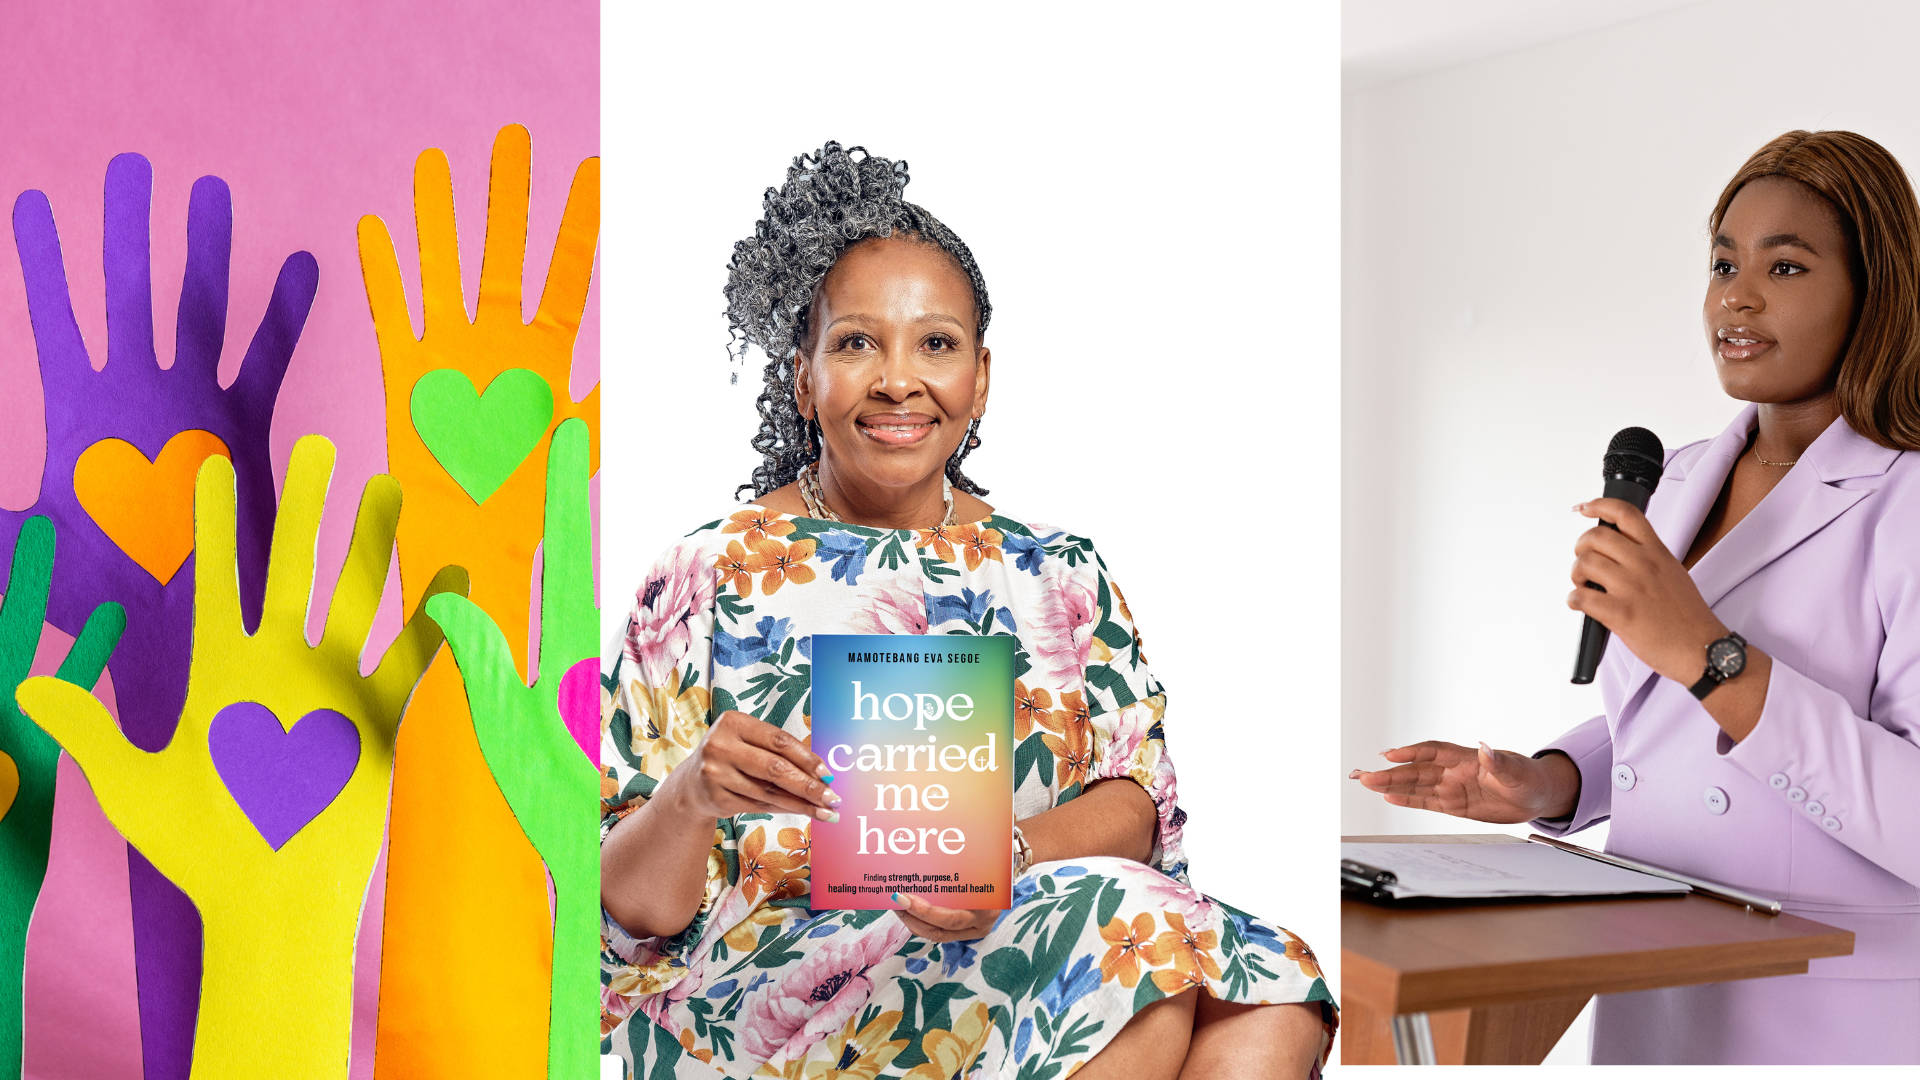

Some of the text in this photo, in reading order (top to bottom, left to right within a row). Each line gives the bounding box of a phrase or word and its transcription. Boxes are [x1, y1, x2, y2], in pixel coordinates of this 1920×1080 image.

[848, 652, 980, 664] MAMOTEBANG EVA SEGOE
[851, 681, 974, 730] hope
[827, 733, 999, 772] carried
[874, 784, 949, 811] me
[857, 816, 965, 854] here
[828, 884, 995, 894] healing through motherhood & mental health
[863, 873, 959, 883] Finding strength, purpose, &
